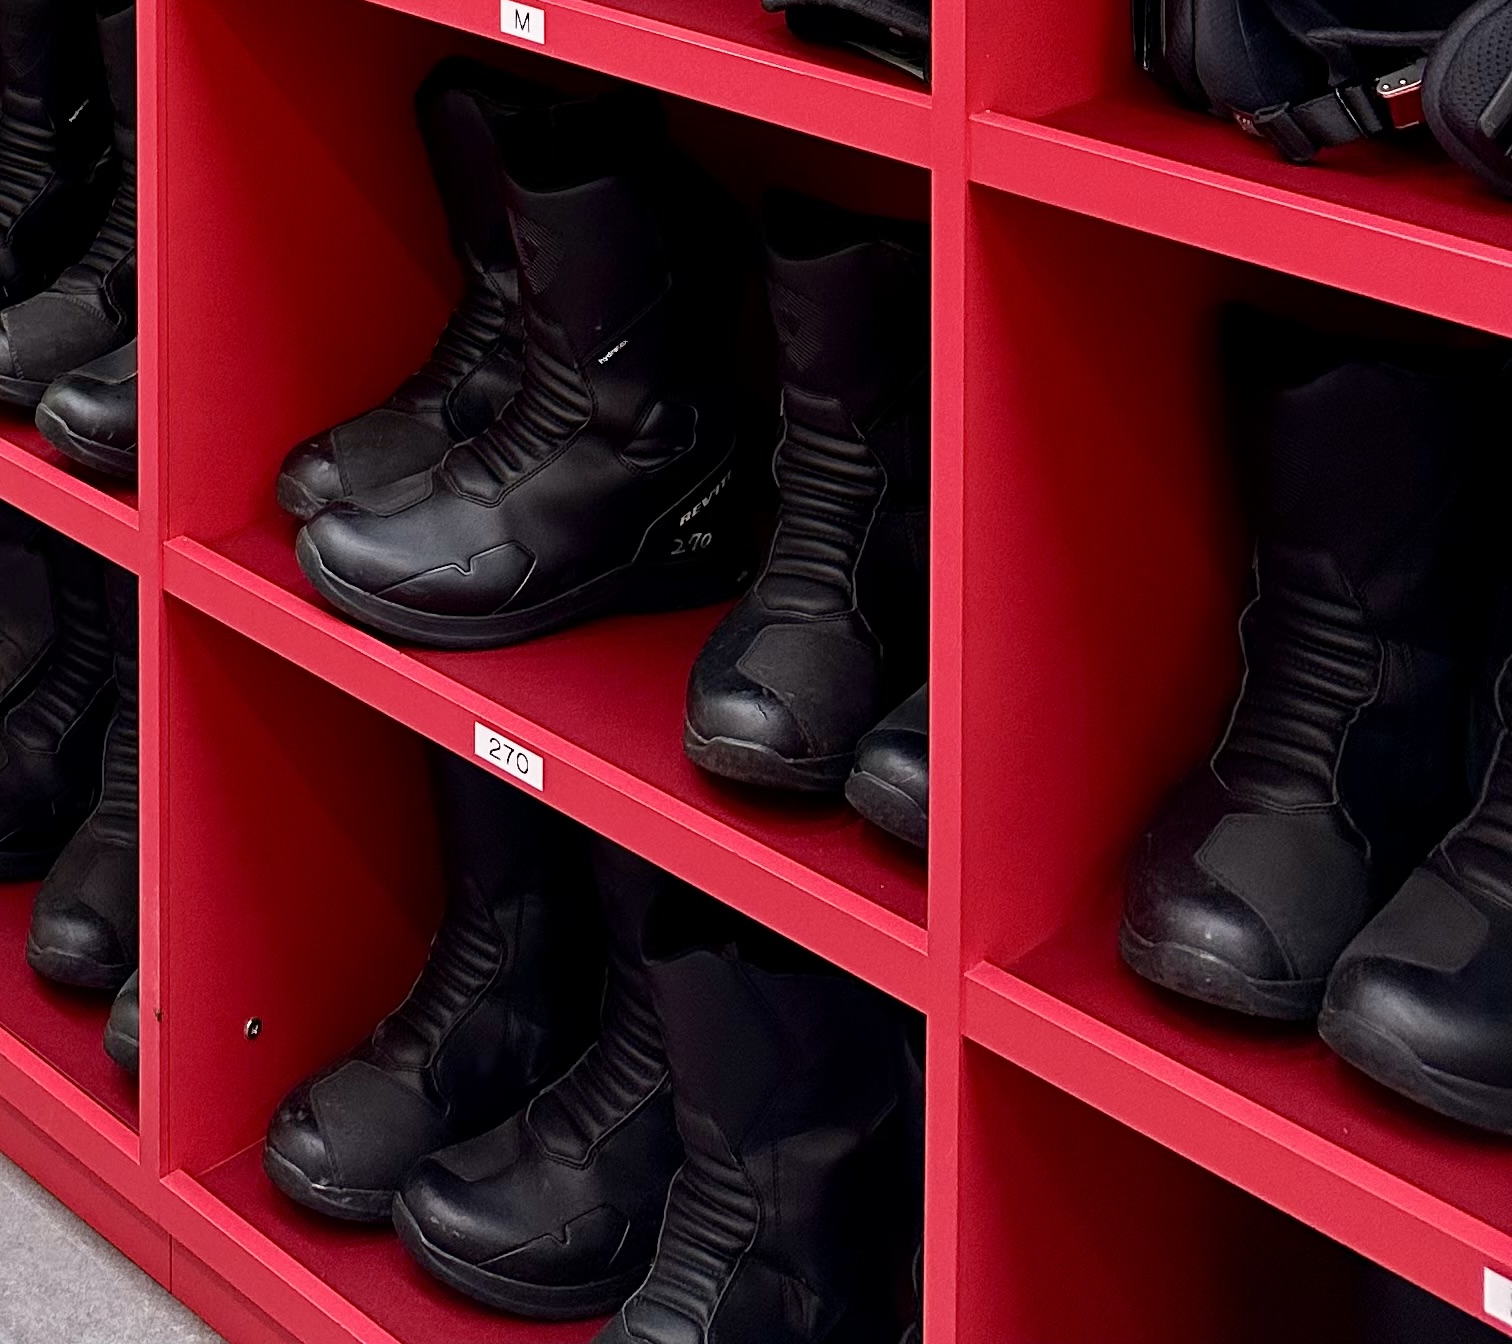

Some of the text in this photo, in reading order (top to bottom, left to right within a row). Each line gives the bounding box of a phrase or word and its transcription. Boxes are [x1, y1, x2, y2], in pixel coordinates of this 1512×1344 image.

[514, 8, 530, 33] M
[670, 531, 713, 555] 270
[489, 737, 529, 775] 270
